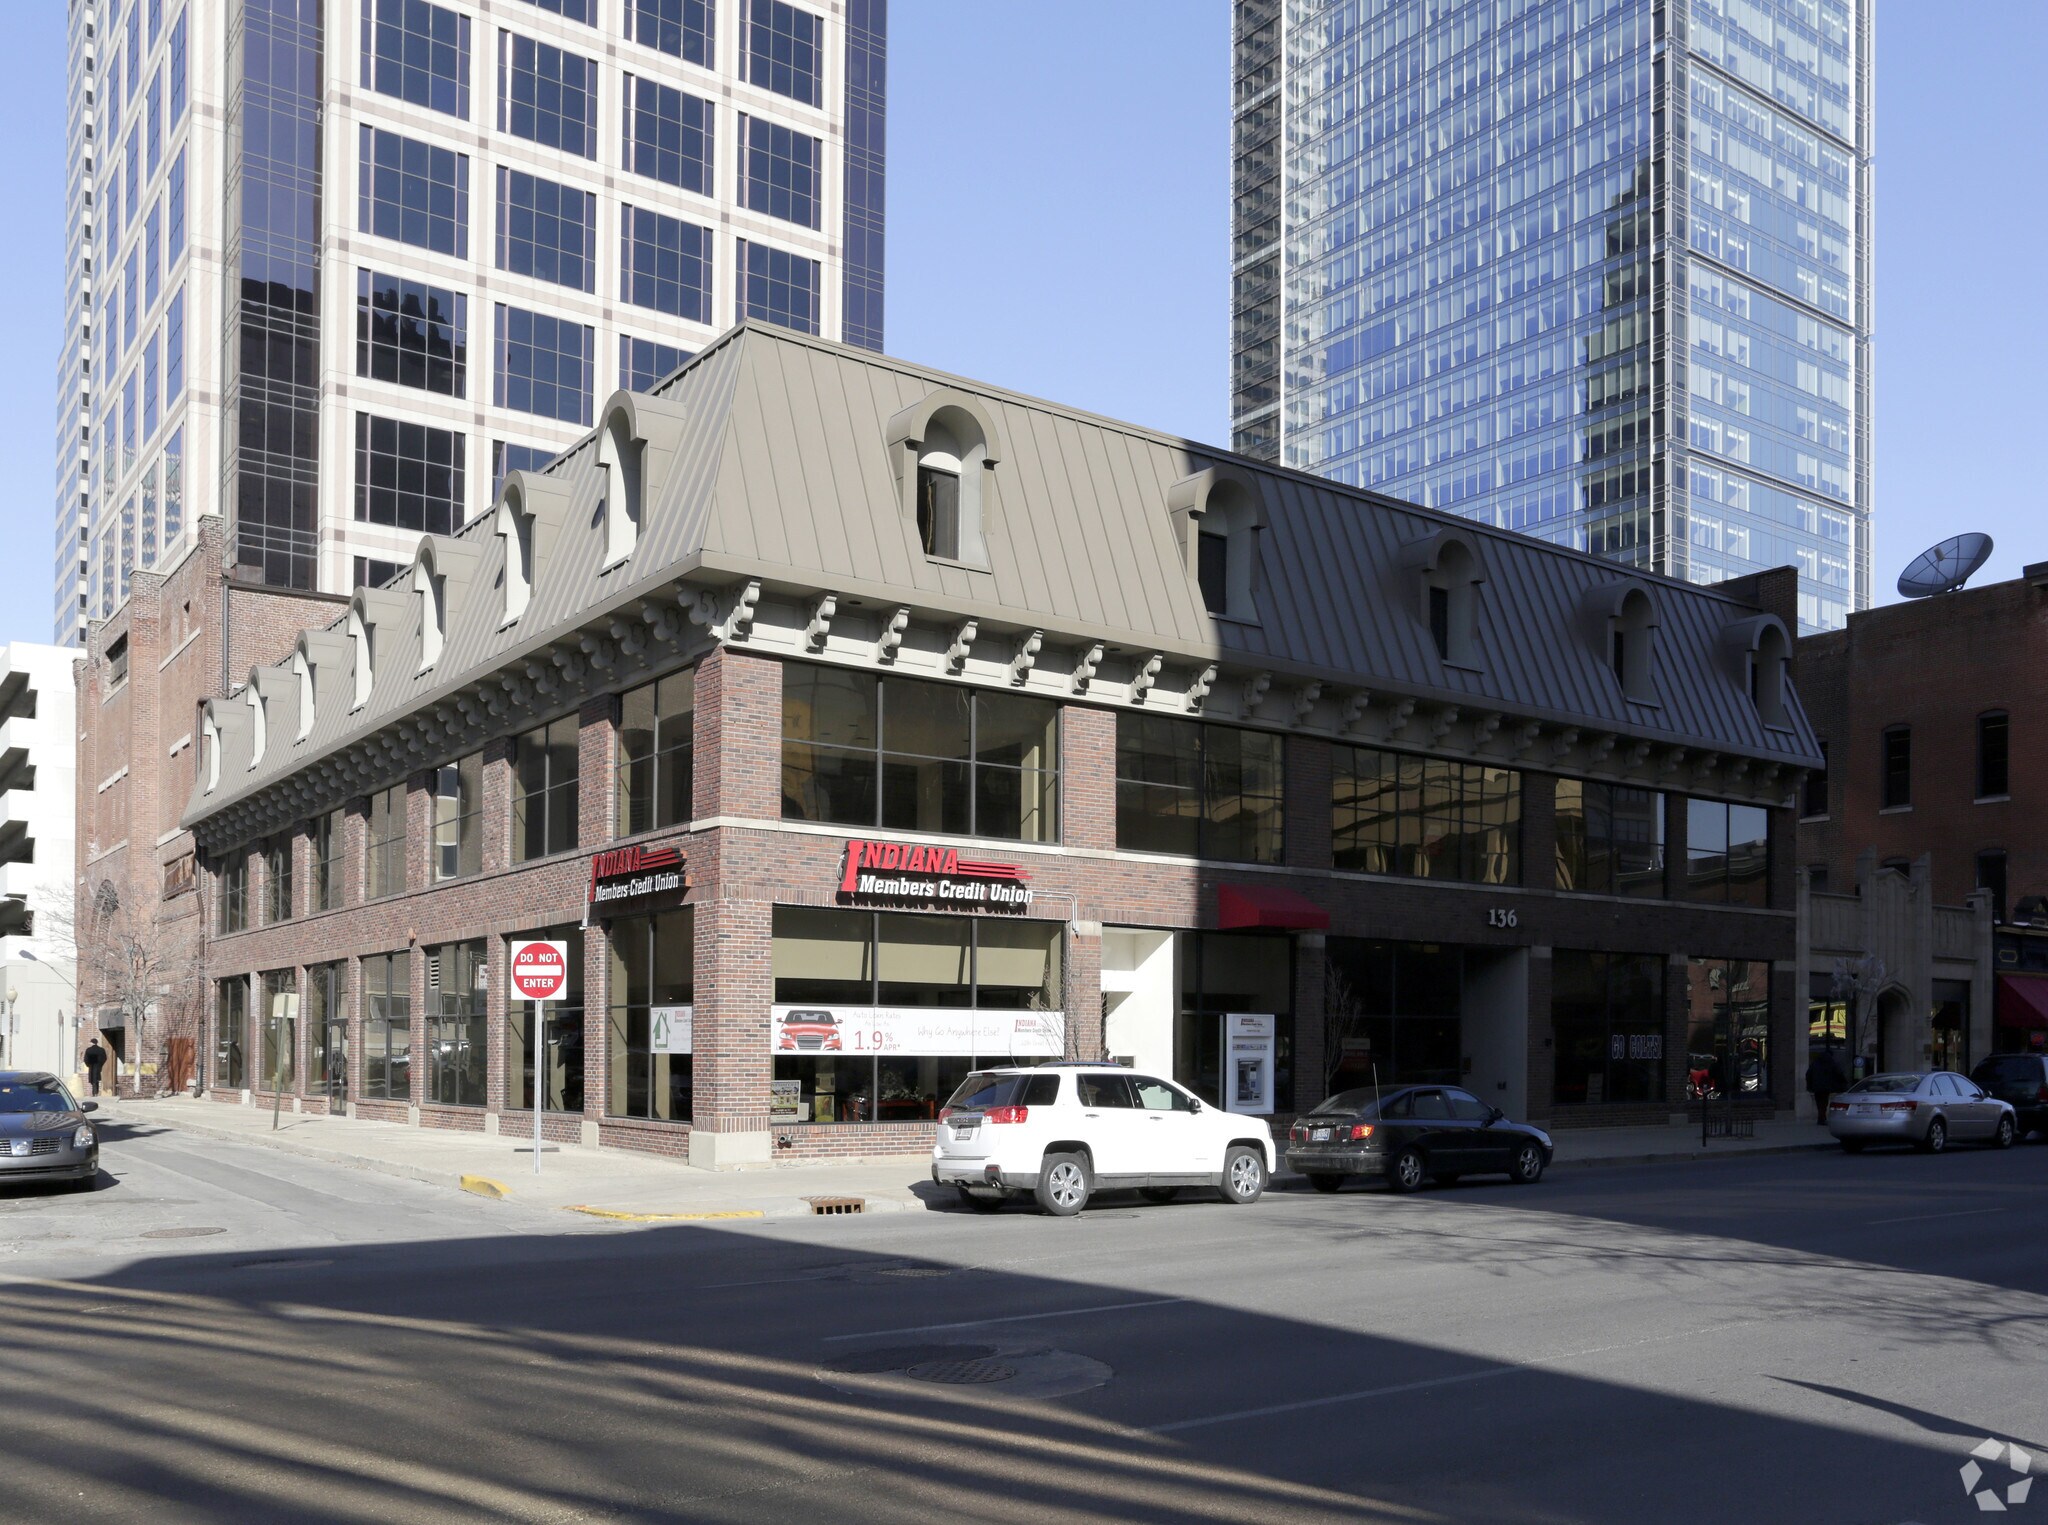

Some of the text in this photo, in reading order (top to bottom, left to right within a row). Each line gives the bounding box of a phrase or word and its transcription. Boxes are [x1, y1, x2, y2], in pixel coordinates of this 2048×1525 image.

[589, 846, 641, 903] INDIANA
[841, 840, 958, 892] INDIANA
[595, 872, 679, 902] Members Credit Union
[859, 875, 1033, 903] Members Credit Union
[1489, 909, 1518, 928] 136
[520, 953, 558, 963] DO NOT
[523, 978, 554, 988] ENTER
[854, 1030, 883, 1050] 1.9
[918, 1025, 1000, 1039] Why Go Anywhere Else?
[1611, 1034, 1663, 1060] GO COLTS!
